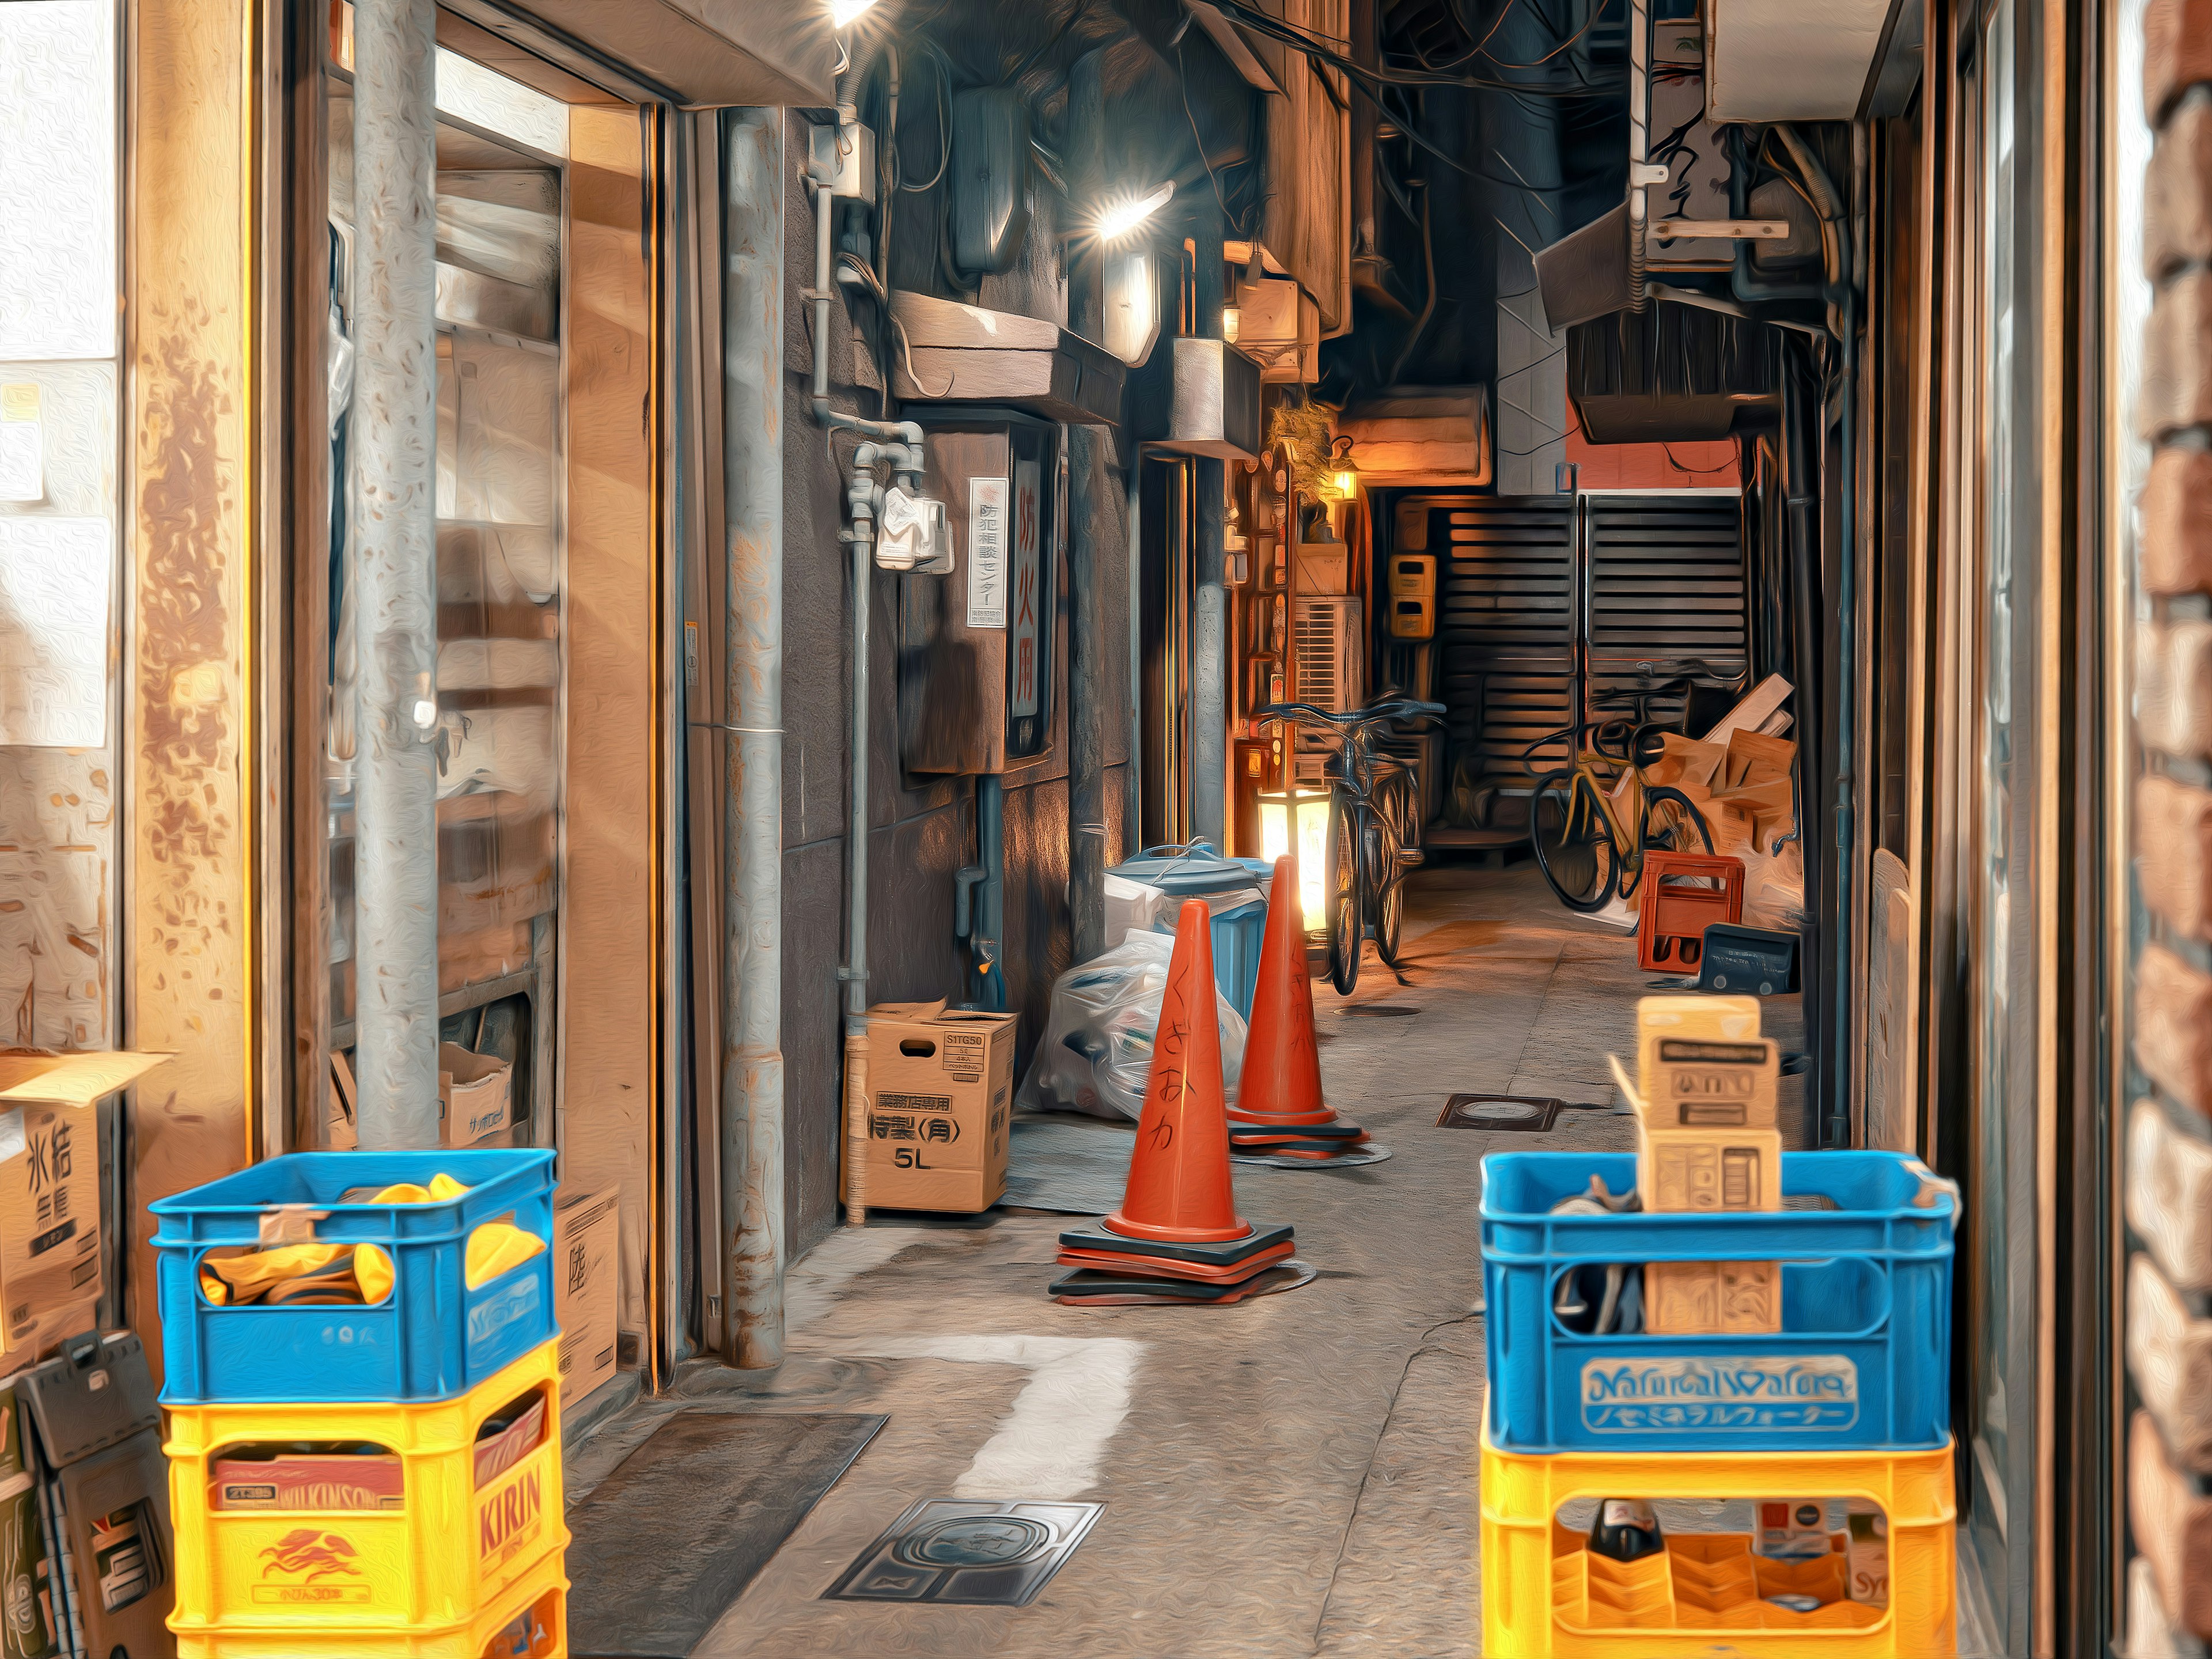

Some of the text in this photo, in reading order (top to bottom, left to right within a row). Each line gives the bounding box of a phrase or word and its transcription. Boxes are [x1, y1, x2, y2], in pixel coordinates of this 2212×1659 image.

[979, 505, 998, 605] 防犯相談センター
[946, 1035, 983, 1046] S1TG50
[878, 1093, 950, 1112] 業務店専用
[26, 1120, 73, 1194] 氷結
[895, 1147, 931, 1170] 5L
[480, 1463, 540, 1559] KIRIN
